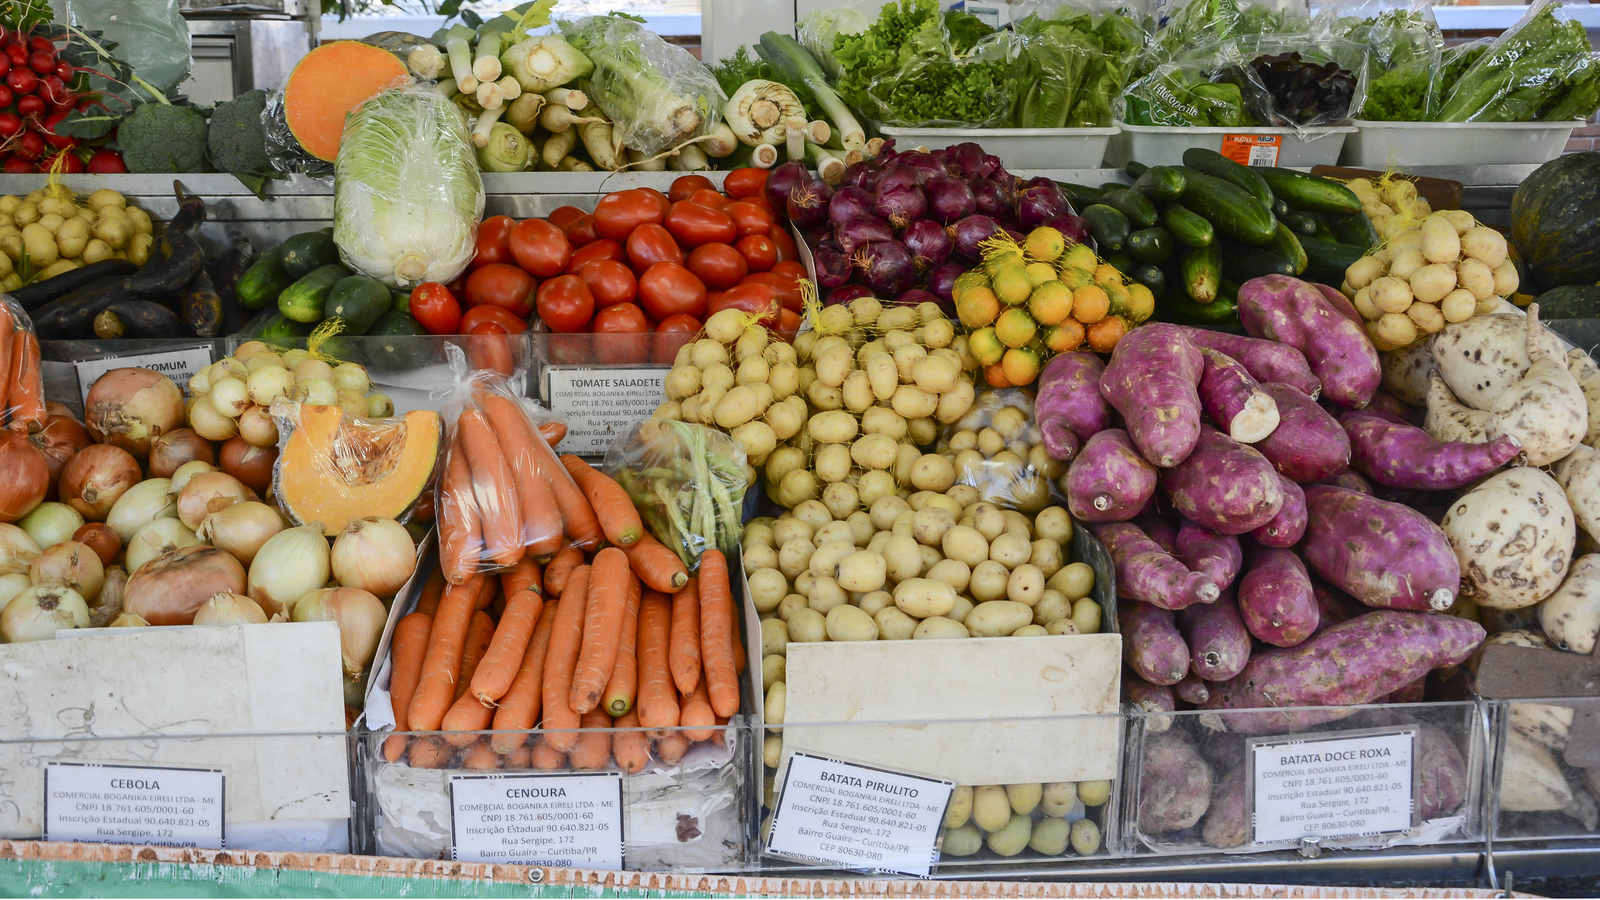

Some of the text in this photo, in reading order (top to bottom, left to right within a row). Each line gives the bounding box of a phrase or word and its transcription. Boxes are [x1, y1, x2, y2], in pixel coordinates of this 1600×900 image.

[571, 378, 661, 388] TOMATE SALADETE
[1280, 747, 1392, 766] BATATA DOCE ROXA
[110, 778, 160, 790] CEBOLA
[792, 780, 837, 794] COMERCIAL
[820, 771, 919, 798] BATATA PIRULITO
[53, 791, 101, 801] COMERCIAL
[506, 787, 567, 798] CENOURA
[809, 795, 831, 806] CNPJ
[1354, 796, 1369, 804] 172
[75, 803, 98, 811] CNPJ
[459, 803, 504, 812] COMERCIAL
[507, 802, 549, 810] BOGANIKA
[550, 801, 574, 809] EIRELI
[59, 815, 210, 827] Inscrição Estadual 90.640.821-05
[480, 814, 502, 823] CNPJ
[791, 802, 927, 832] Inscrição Estadual 90.640.821-05
[96, 828, 114, 836] Rua
[157, 829, 173, 837] 172
[466, 823, 610, 836] Inscrição Estadual 90.640.821-05
[822, 819, 838, 829] Rua
[876, 828, 892, 838] 172
[1303, 823, 1319, 832] CEP
[502, 837, 518, 845] Rua
[559, 835, 575, 844] 172
[798, 827, 823, 838] Bairro
[862, 838, 910, 854] Curitiba/PR
[480, 849, 506, 858] Bairro
[547, 846, 598, 856] Curitiba/PR
[819, 842, 837, 852] CEP
